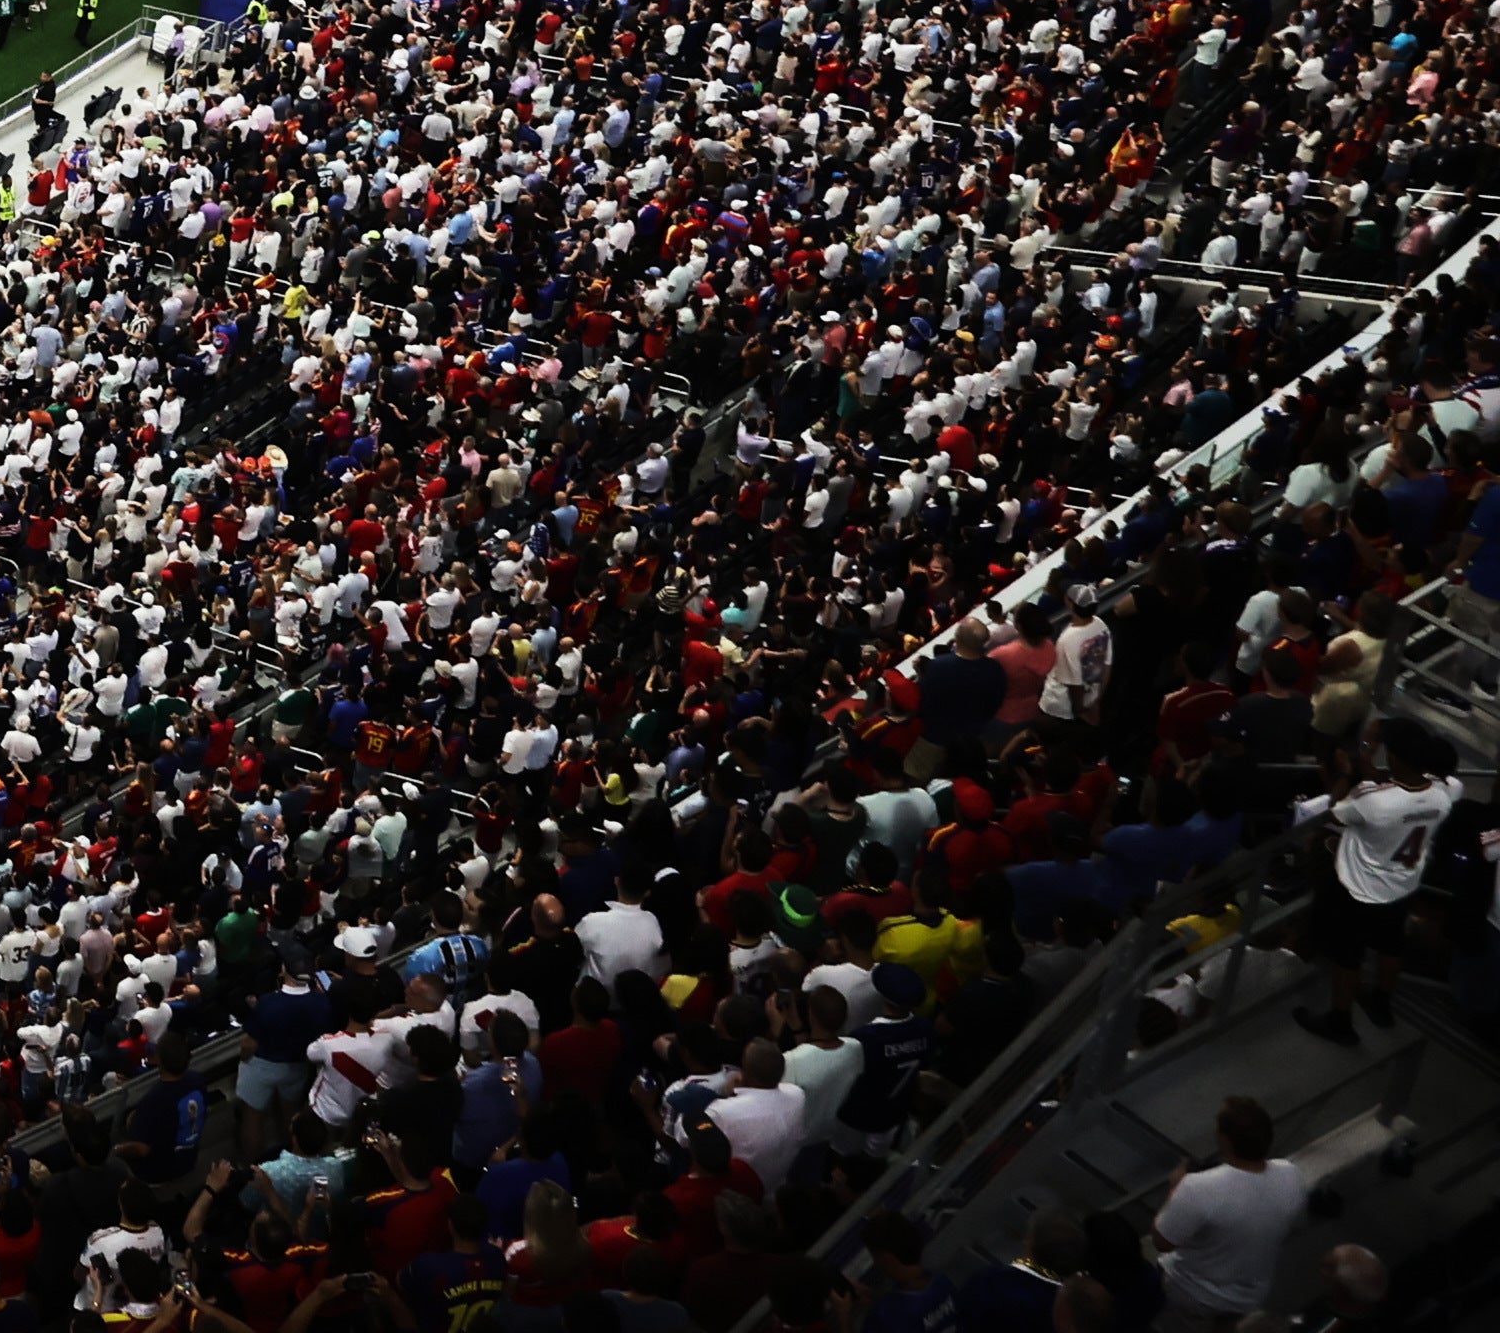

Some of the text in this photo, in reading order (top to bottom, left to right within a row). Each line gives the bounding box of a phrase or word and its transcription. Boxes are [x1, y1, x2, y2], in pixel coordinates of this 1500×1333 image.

[367, 736, 384, 753] 19
[1389, 825, 1428, 866] 4
[13, 945, 29, 963] 33
